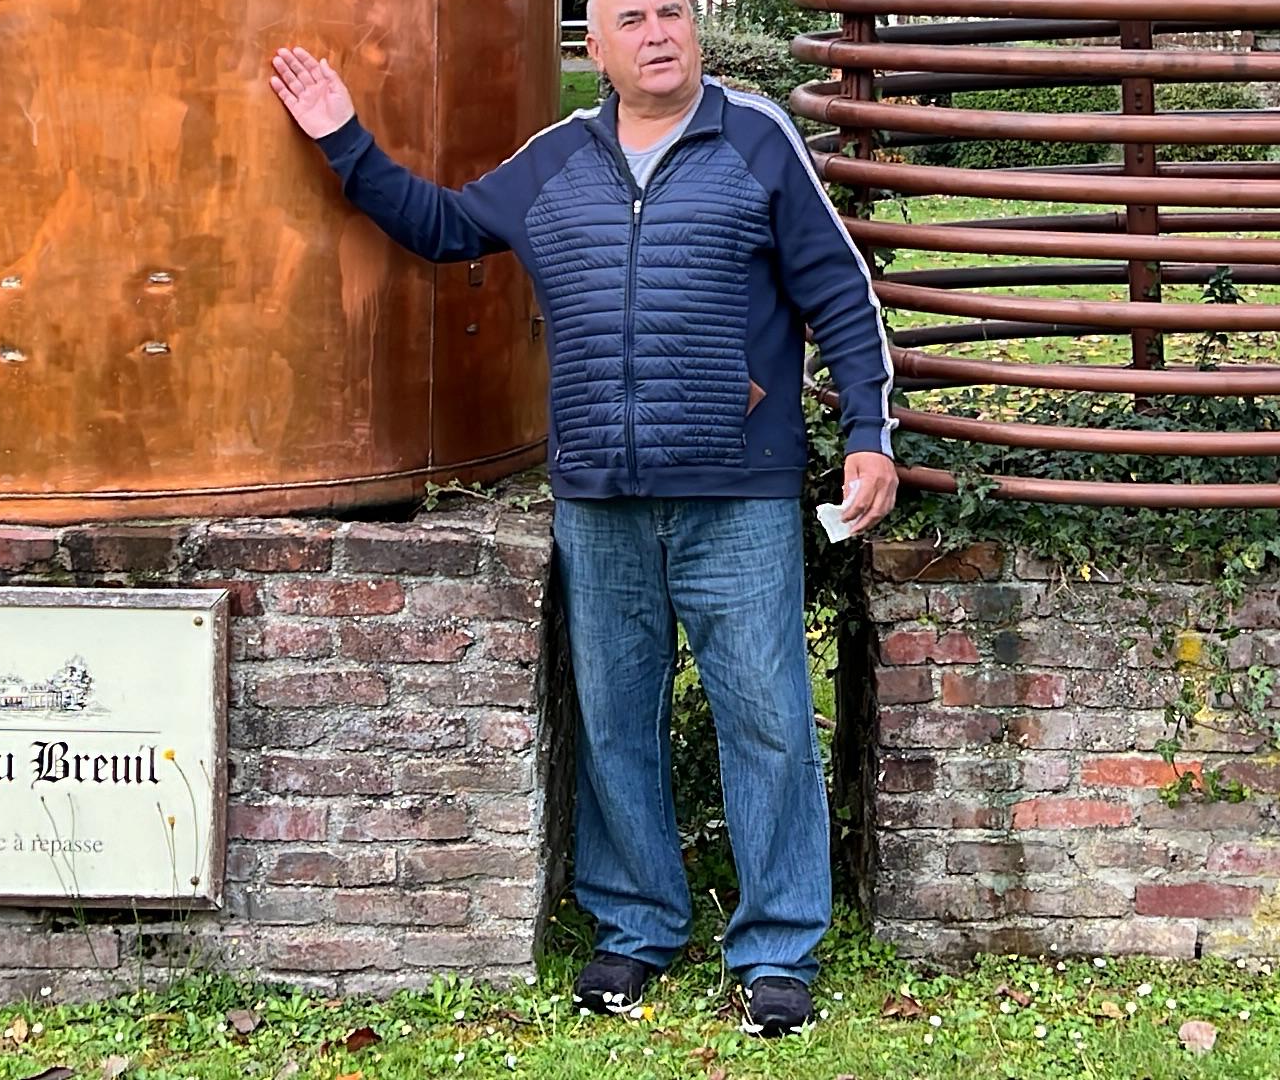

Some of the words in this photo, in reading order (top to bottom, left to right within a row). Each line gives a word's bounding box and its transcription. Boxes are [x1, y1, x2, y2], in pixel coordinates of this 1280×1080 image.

[29, 740, 161, 790] Breuil
[13, 832, 24, 852] à
[31, 837, 104, 857] repasse
